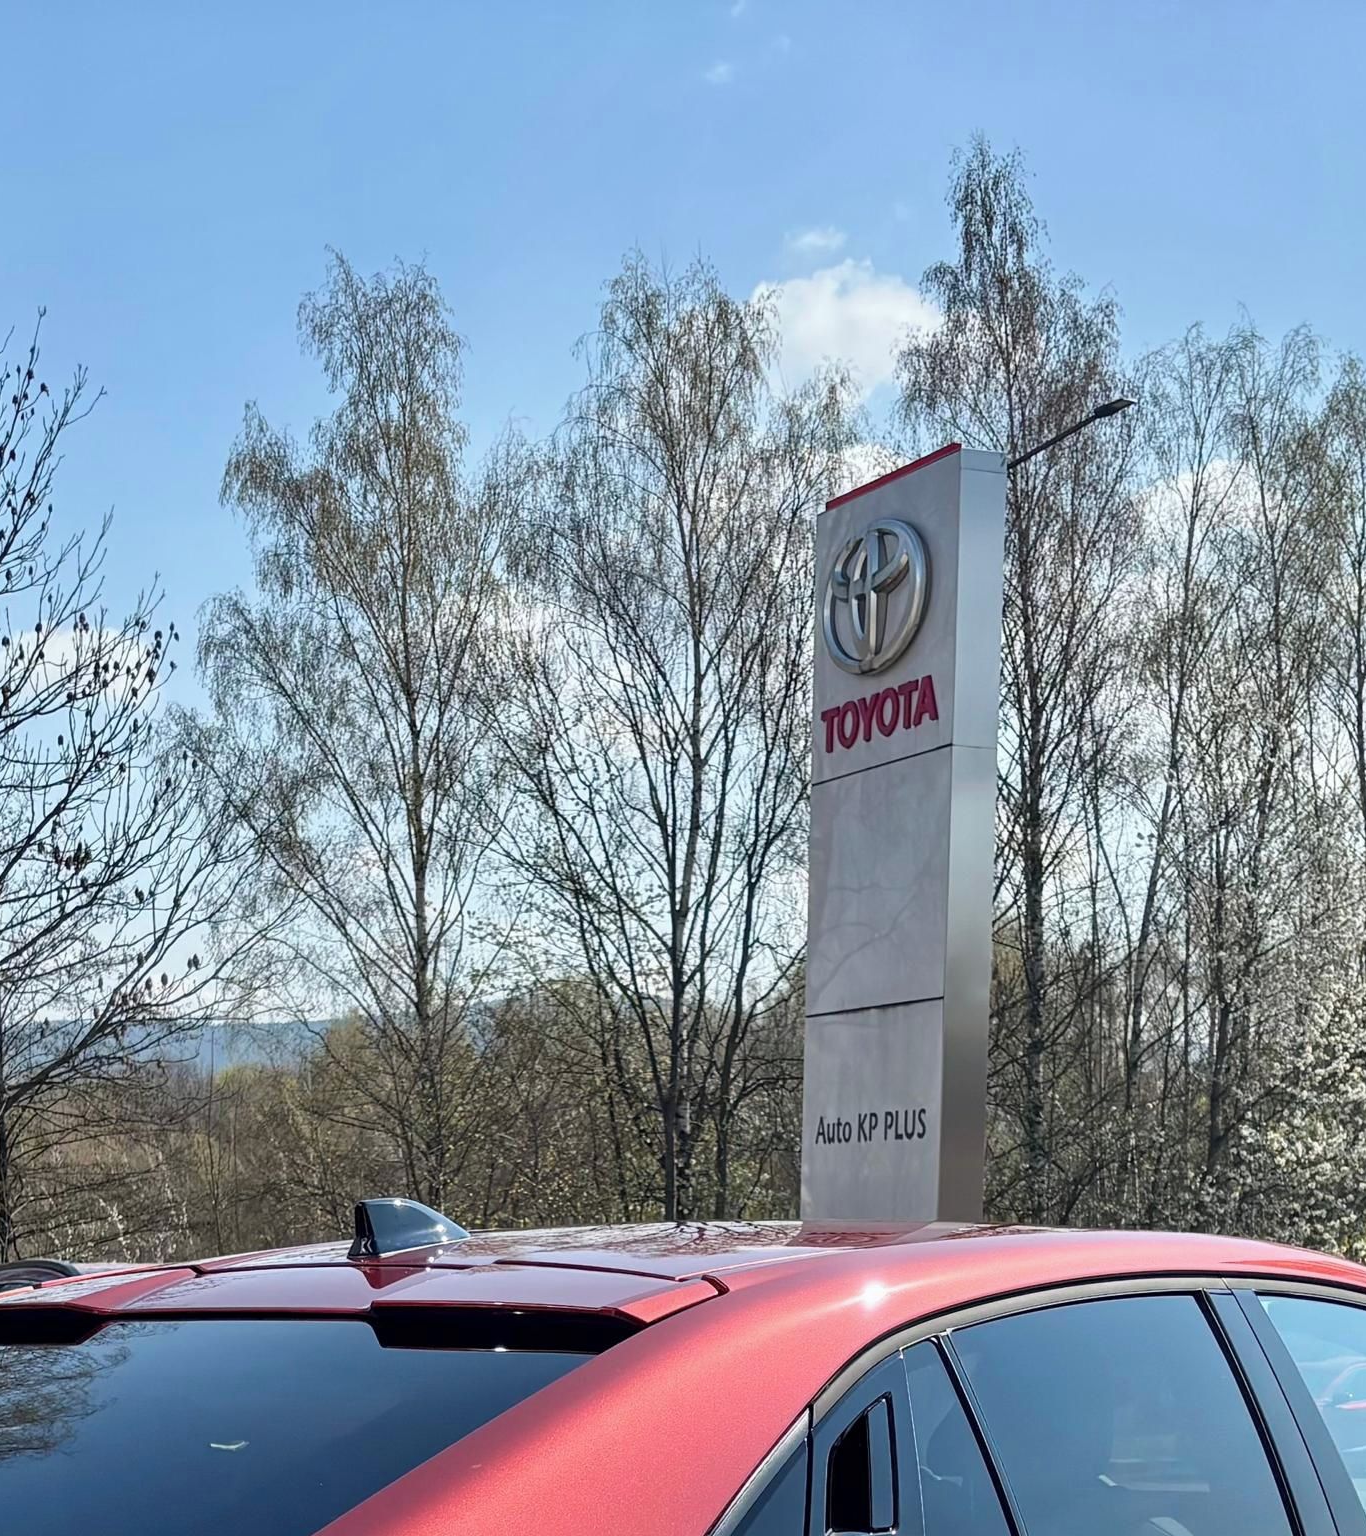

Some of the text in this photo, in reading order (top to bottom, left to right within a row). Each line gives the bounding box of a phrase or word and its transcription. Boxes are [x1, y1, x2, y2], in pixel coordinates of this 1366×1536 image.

[821, 674, 939, 753] TOYOTA
[815, 1108, 926, 1144] Auto KP PLUS
